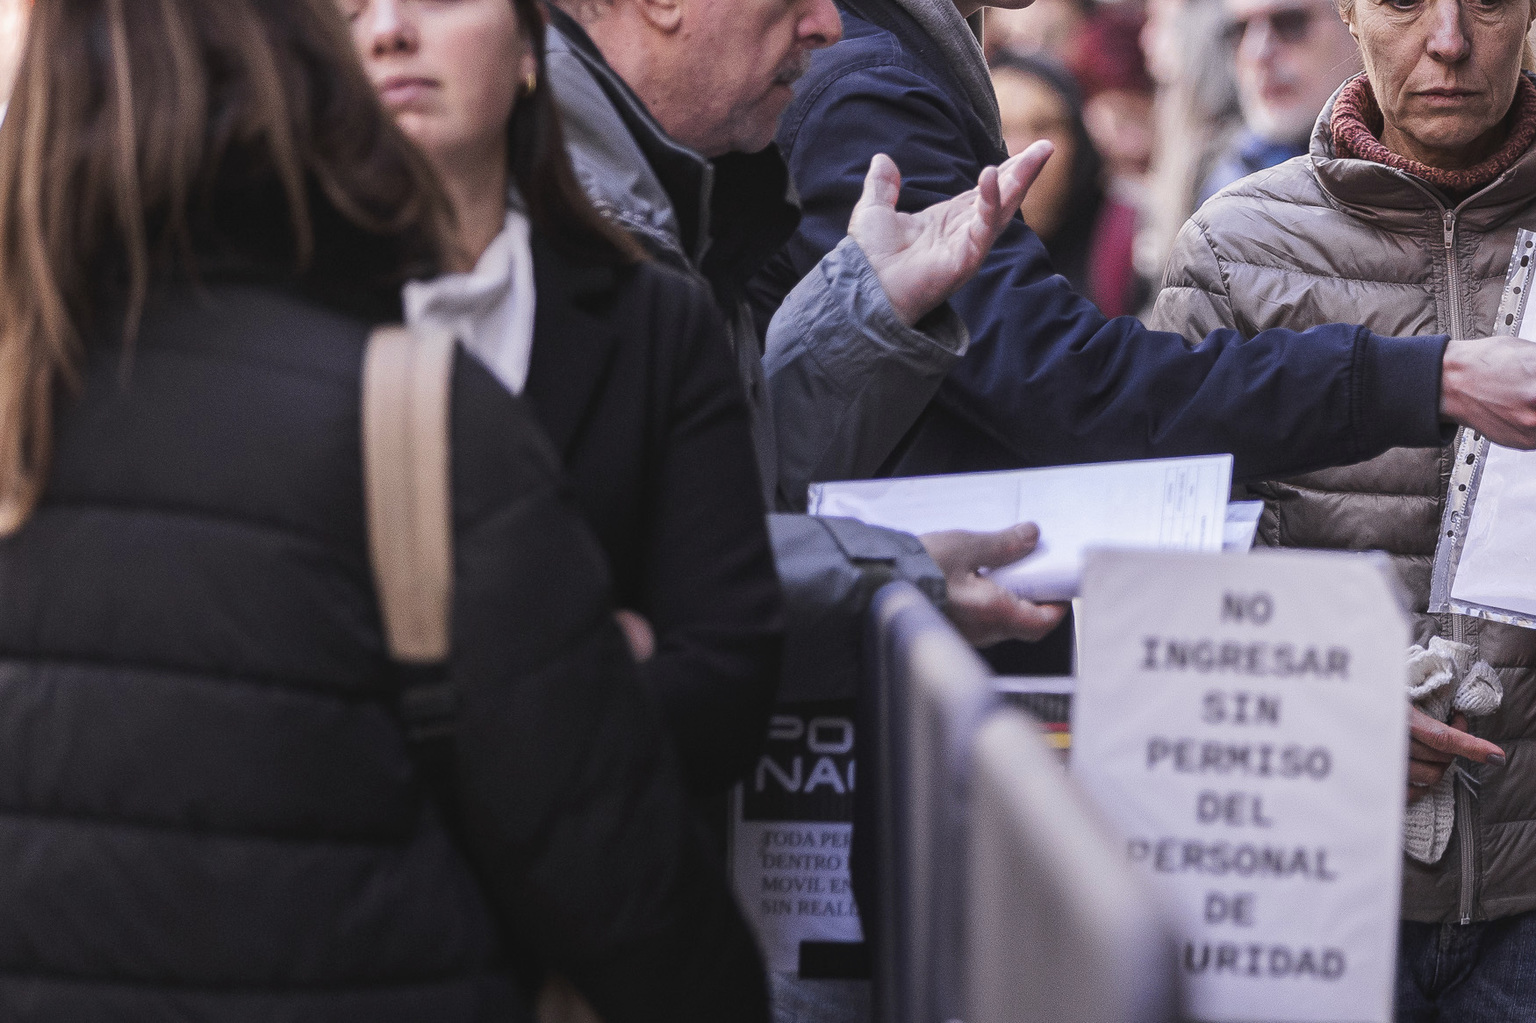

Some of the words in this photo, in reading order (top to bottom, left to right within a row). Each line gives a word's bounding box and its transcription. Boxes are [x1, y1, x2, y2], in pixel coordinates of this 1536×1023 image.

[1220, 592, 1273, 625] NO
[1141, 637, 1351, 679] INGRESAR
[1202, 690, 1281, 726] SIN
[1146, 737, 1332, 780] PERMISO
[1196, 790, 1272, 828] DEL
[762, 854, 841, 871] DENTRO
[1203, 891, 1256, 927] DE
[1183, 940, 1347, 981] URIDAD
